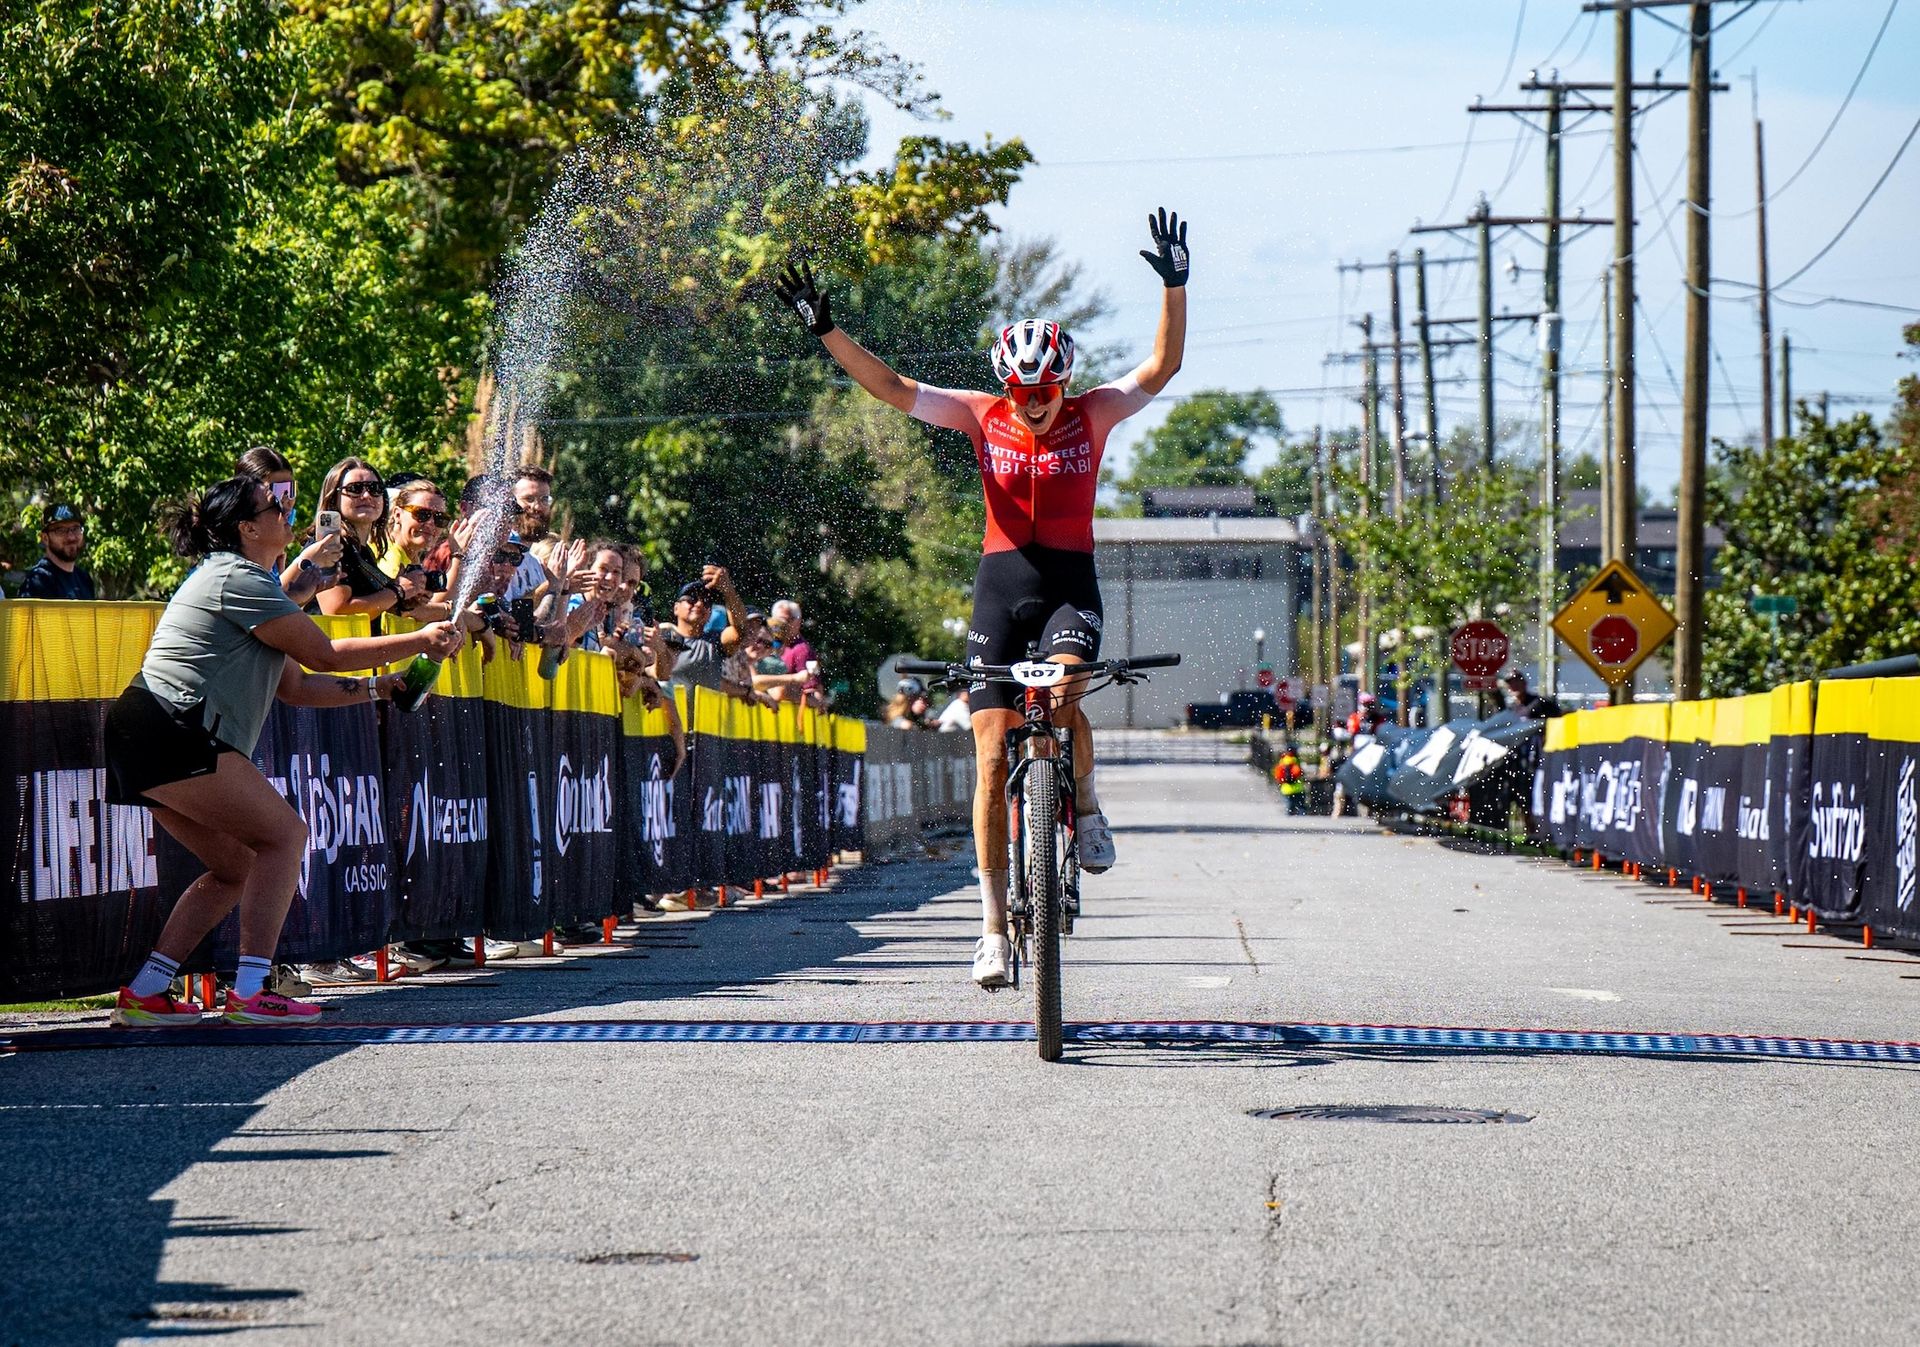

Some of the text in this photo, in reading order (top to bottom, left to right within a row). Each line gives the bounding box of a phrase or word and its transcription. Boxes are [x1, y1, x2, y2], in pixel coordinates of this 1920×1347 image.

[992, 417, 1025, 436] SPIER
[1049, 425, 1084, 445] GARMIN
[983, 441, 1028, 462] SEATTLE
[1030, 447, 1077, 464] COFFEE
[983, 456, 1091, 475] SABI SABI
[1455, 637, 1507, 661] STOP
[1020, 669, 1057, 678] 107
[345, 863, 387, 892] CASSIC
[256, 1000, 289, 1013] HOKA
